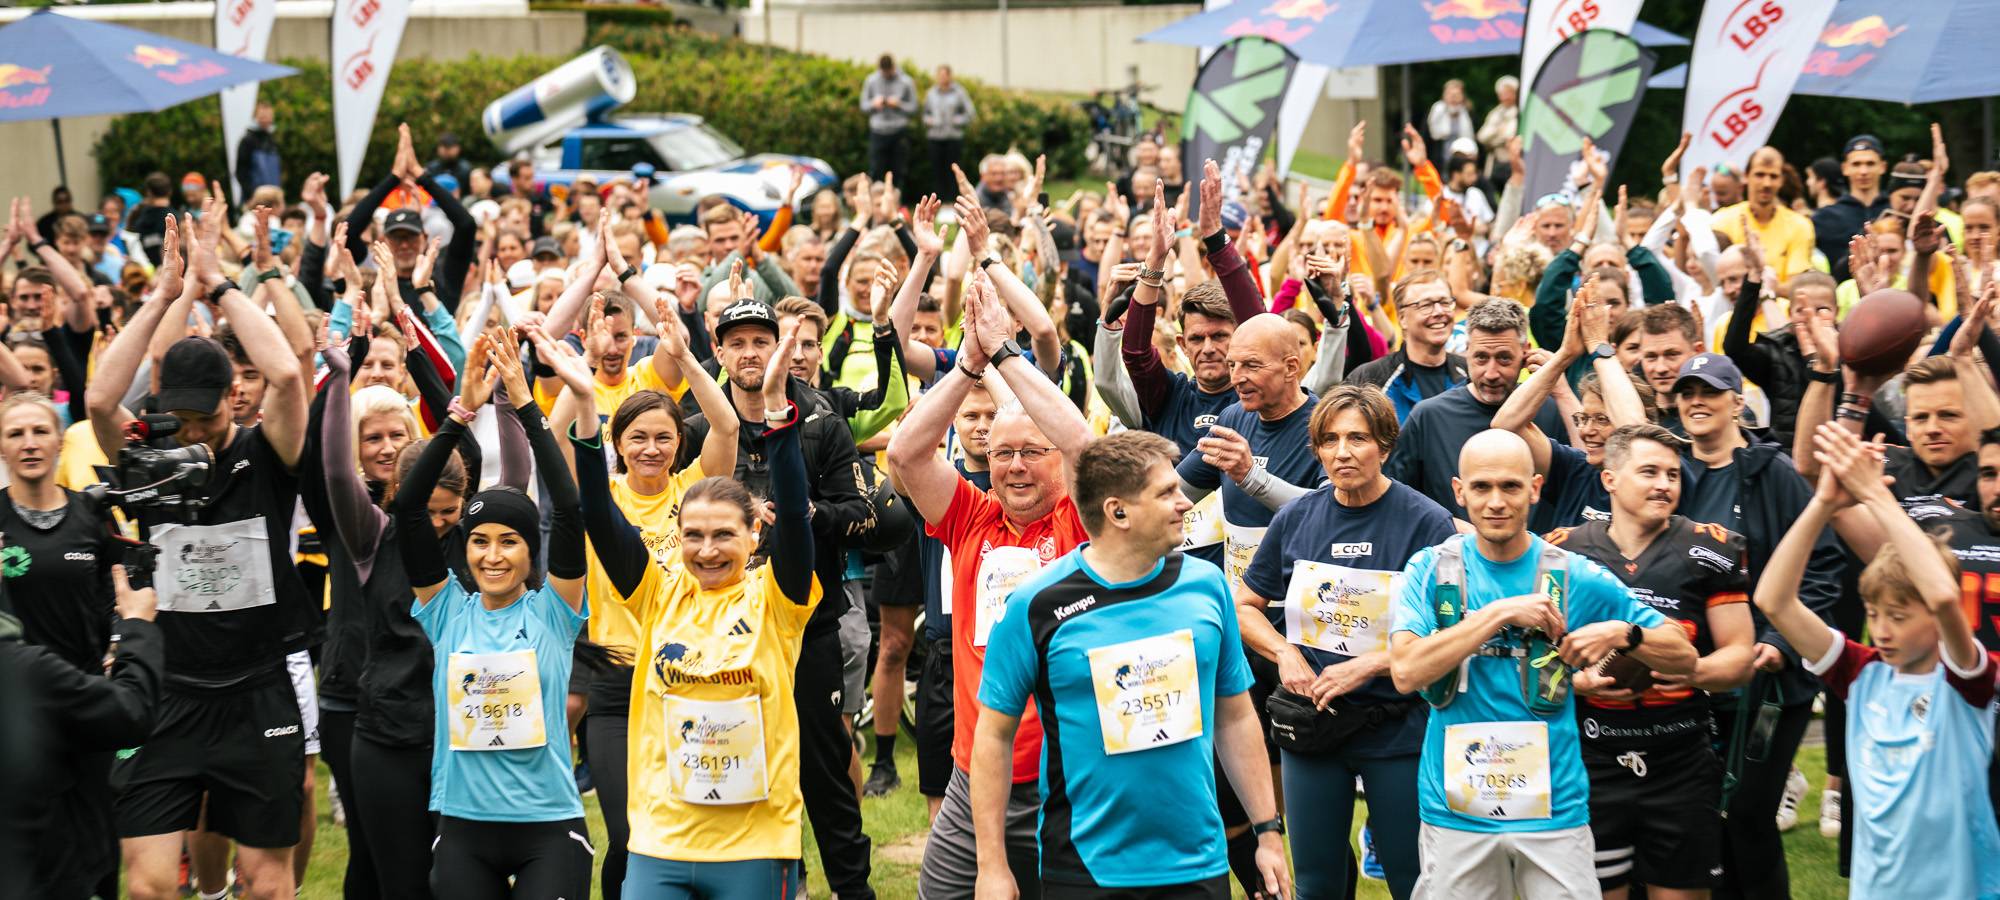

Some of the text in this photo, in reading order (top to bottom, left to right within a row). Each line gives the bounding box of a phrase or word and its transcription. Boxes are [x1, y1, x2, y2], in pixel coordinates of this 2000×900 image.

[1729, 0, 1784, 51] LBS
[1711, 97, 1764, 149] LBS
[1691, 356, 1709, 370] P
[1183, 510, 1204, 524] 621
[1342, 544, 1370, 554] CDU
[1053, 594, 1096, 621] Kempa
[1317, 610, 1369, 629] 239258
[464, 702, 523, 719] 219618
[1121, 689, 1181, 716] 235517
[264, 724, 299, 738] COACH
[682, 753, 741, 771] 236191
[1467, 774, 1527, 789] 170368
